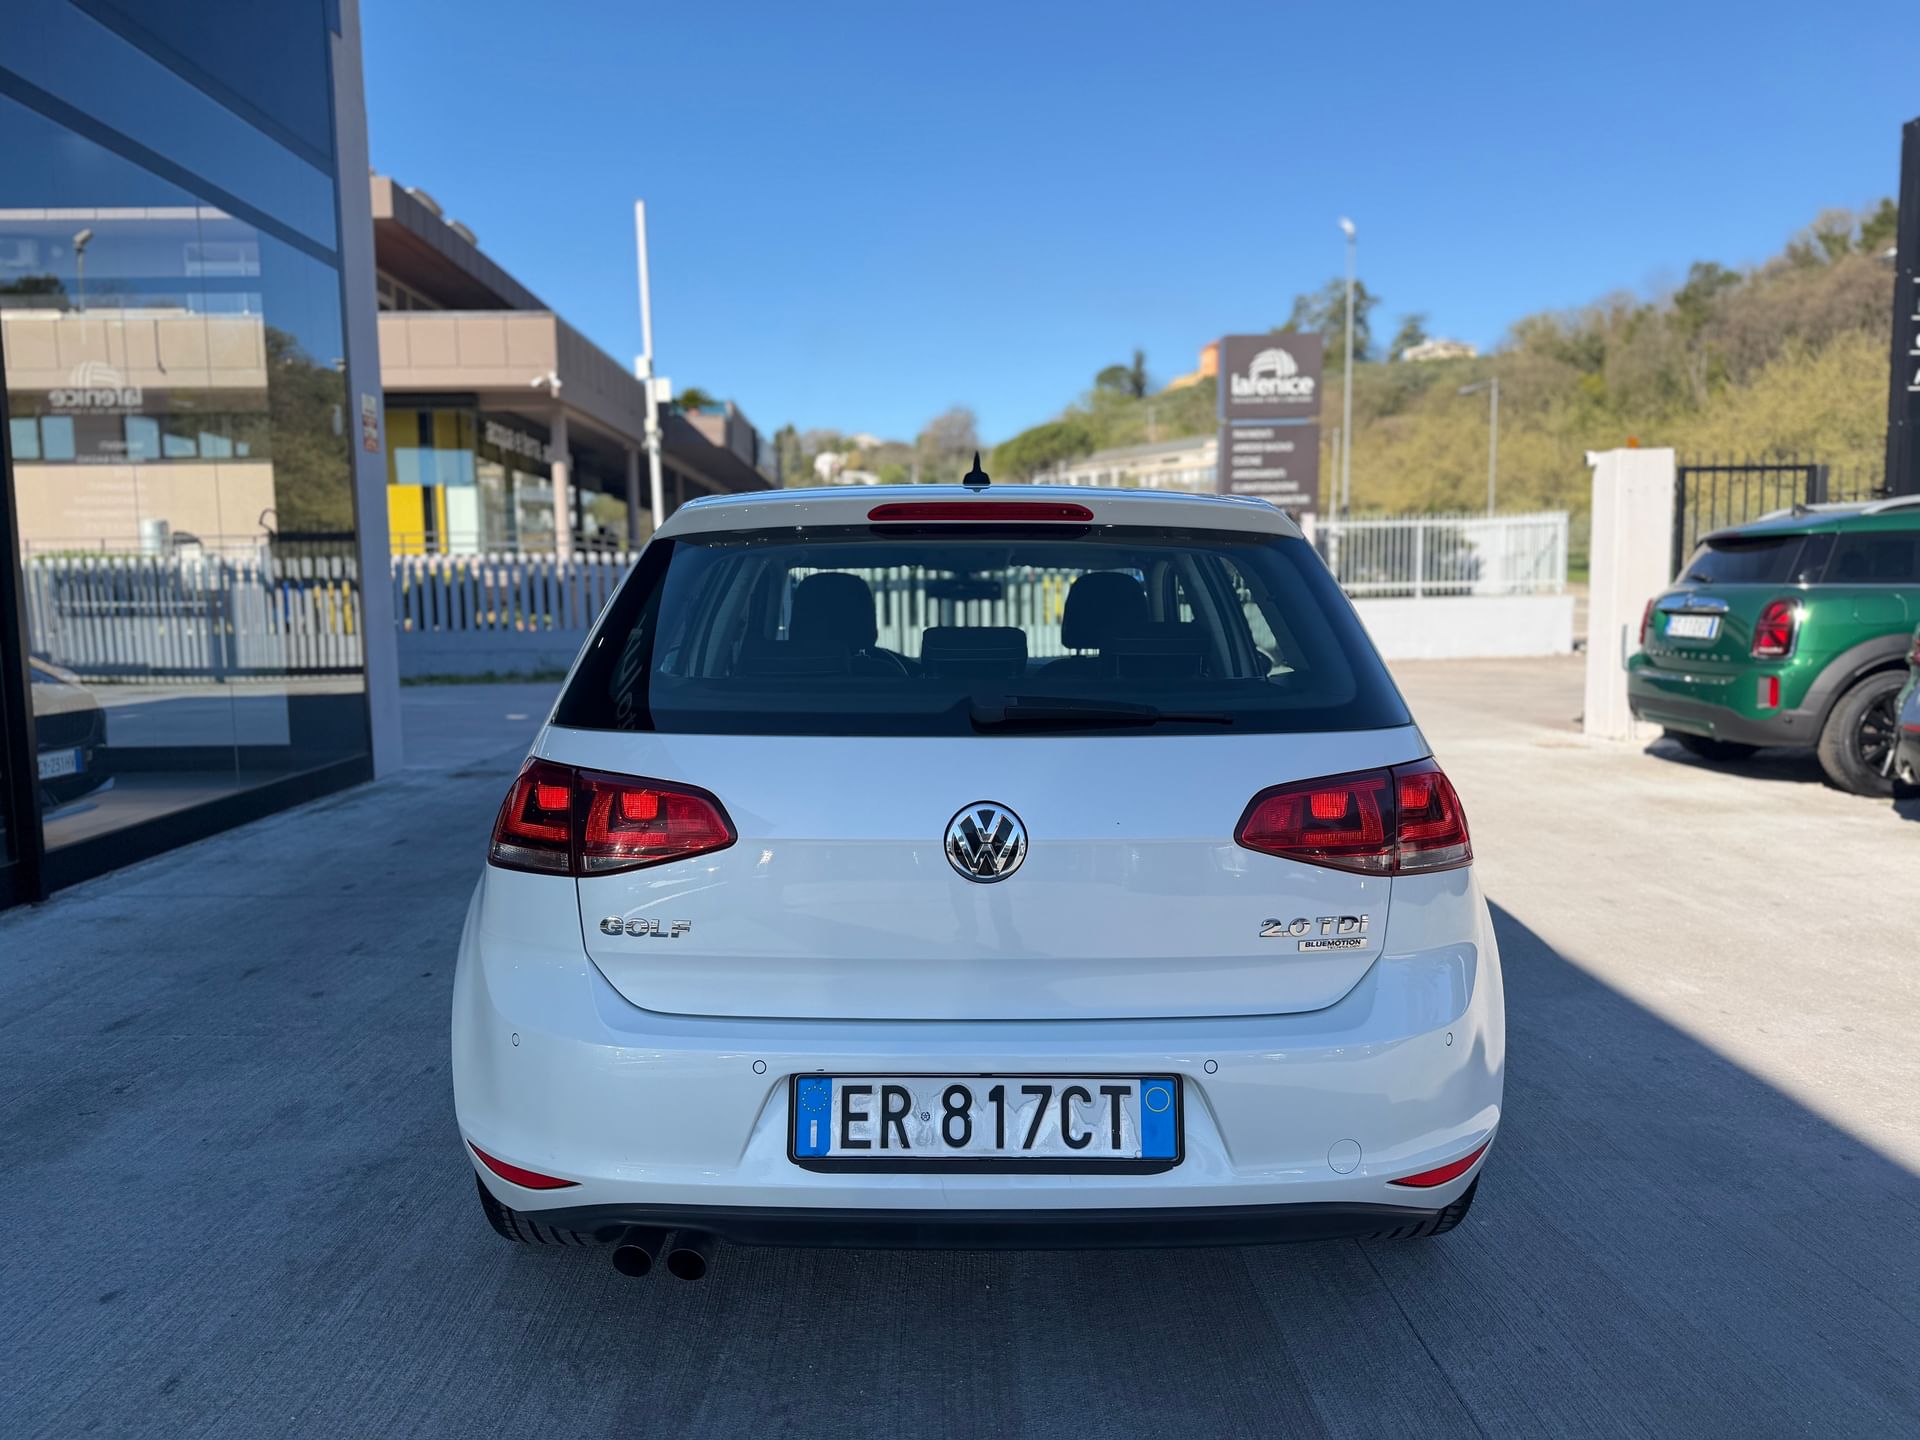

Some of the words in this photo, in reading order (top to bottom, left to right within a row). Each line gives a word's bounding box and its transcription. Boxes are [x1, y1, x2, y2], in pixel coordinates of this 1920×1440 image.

[600, 916, 691, 938] GOLF
[1259, 918, 1311, 937] 2.0
[1305, 939, 1361, 948] BLUEMOTION
[840, 1085, 912, 1149] ER
